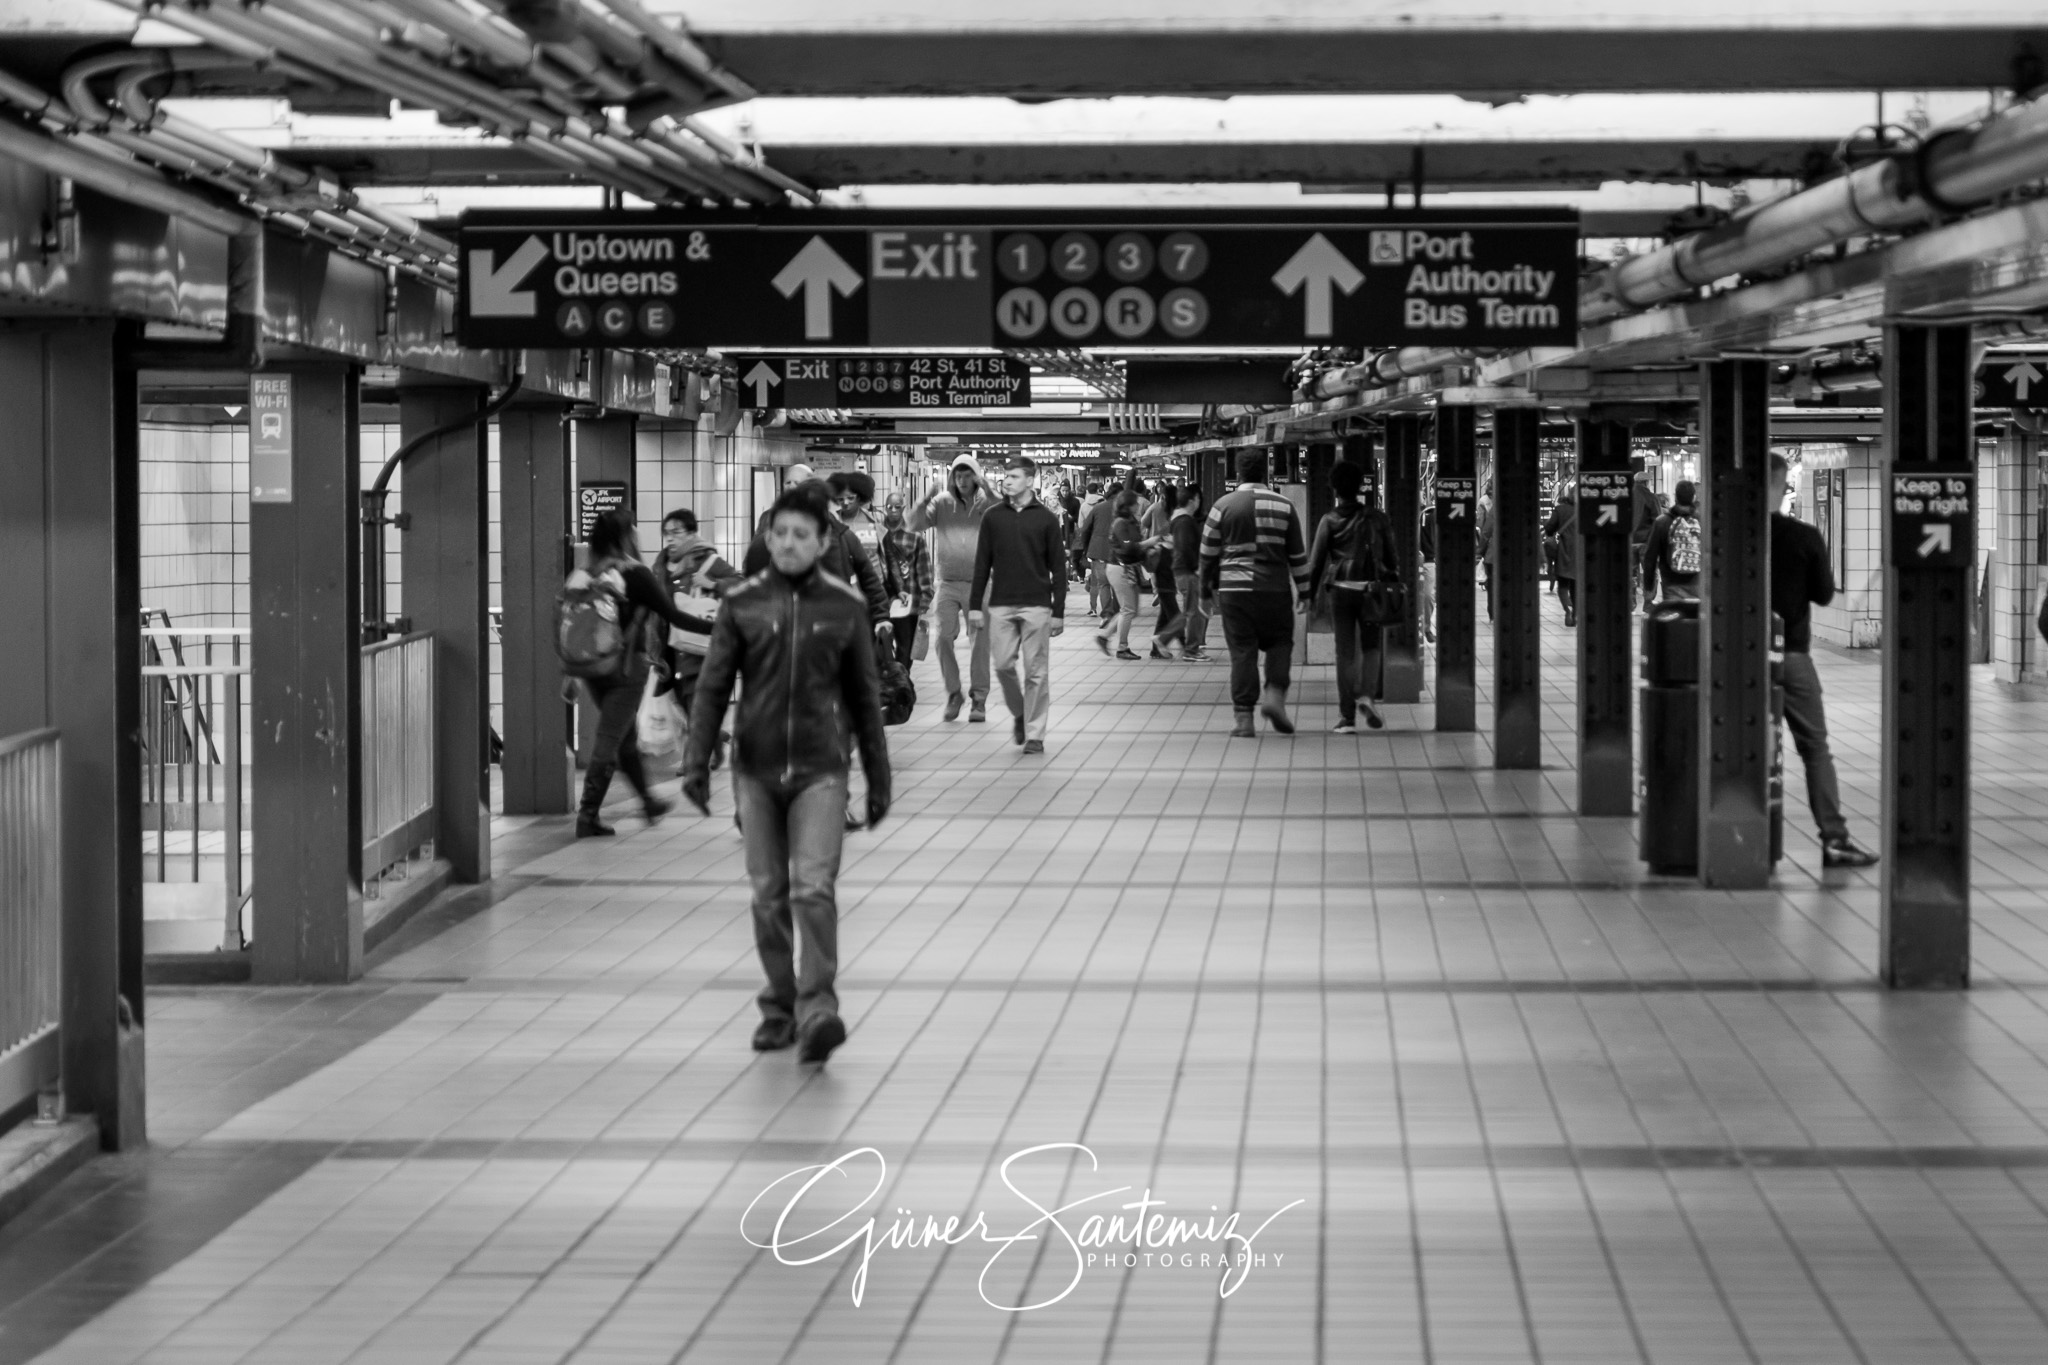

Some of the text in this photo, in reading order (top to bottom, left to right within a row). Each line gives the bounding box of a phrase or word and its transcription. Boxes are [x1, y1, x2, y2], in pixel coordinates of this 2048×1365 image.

[553, 231, 711, 267] Uptown &
[1405, 231, 1473, 260] Port
[872, 232, 978, 279] Exit
[1013, 243, 1195, 271] 1 2 3 7
[554, 265, 678, 296] Queens
[1406, 265, 1555, 298] Authority
[564, 306, 664, 330] A C E
[1011, 298, 1195, 327] N Q R S
[1404, 299, 1559, 328] Bus Term
[786, 360, 829, 379] Exit
[843, 362, 902, 373] 1 2 3 7
[909, 359, 1006, 376] 42 St, 41 St
[255, 380, 287, 393] FREE
[910, 375, 1021, 392] Port Authority
[255, 395, 287, 408] WI-FI
[910, 391, 1011, 405] Bus Terminal
[1360, 485, 1373, 493] ght
[1437, 480, 1473, 491] Keep to
[1580, 474, 1627, 488] Keep to
[1895, 477, 1967, 497] Keep to
[1437, 490, 1474, 500] the right
[1581, 486, 1629, 500] the right
[1895, 496, 1970, 516] the right
